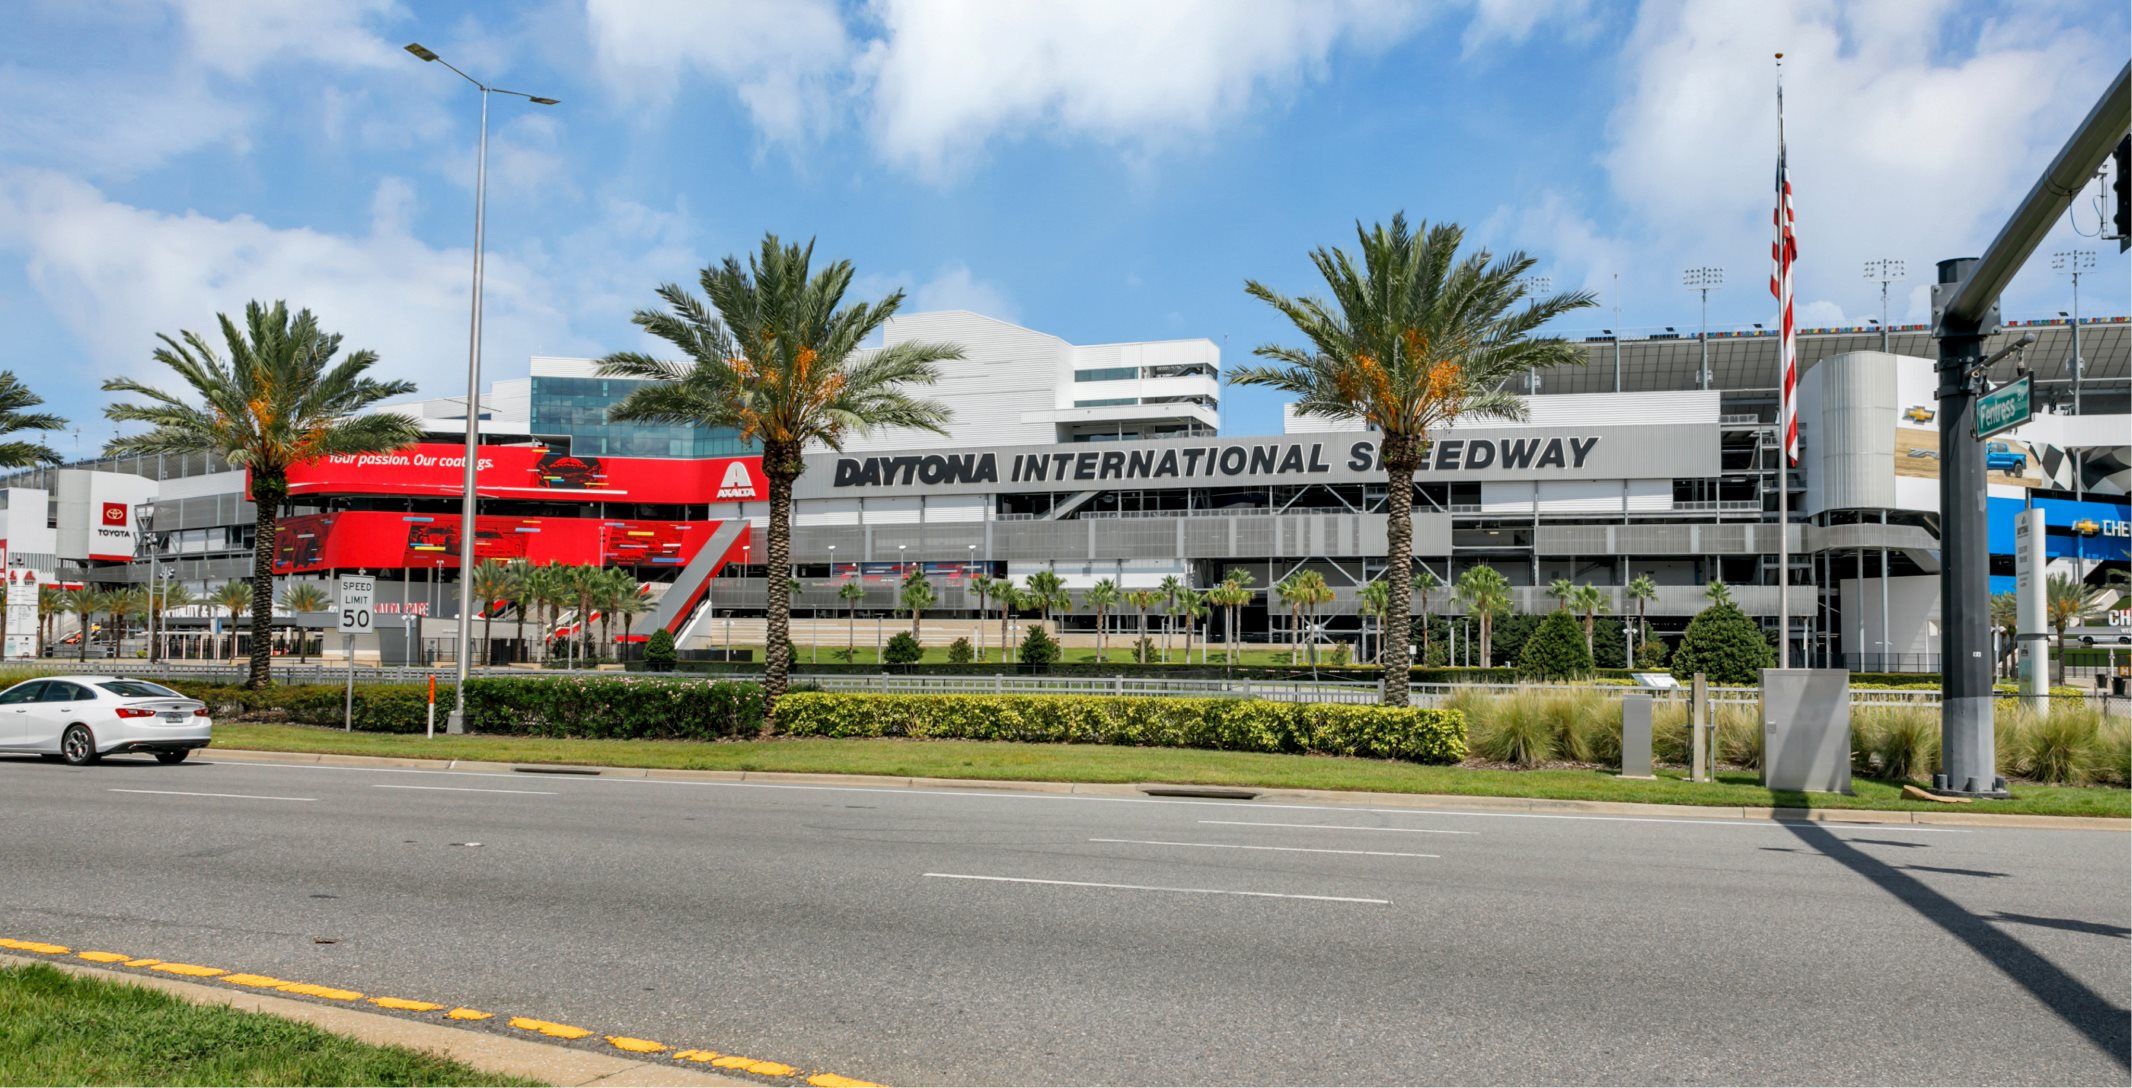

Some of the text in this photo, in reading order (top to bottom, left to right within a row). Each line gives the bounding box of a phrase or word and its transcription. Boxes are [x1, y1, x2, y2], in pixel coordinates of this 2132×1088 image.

[1980, 398, 2016, 429] Fentress
[358, 453, 410, 468] passion.
[413, 454, 437, 466] Our
[439, 457, 494, 471] coatgs.
[834, 436, 1601, 487] DAYTONA INTERNATIONAL SEDWAY
[716, 488, 756, 498] AXALTA
[98, 529, 130, 537] TOYOTA
[2103, 519, 2131, 537] CHE
[343, 582, 372, 591] SPEED
[345, 596, 368, 604] LIMIT
[343, 609, 370, 628] 50
